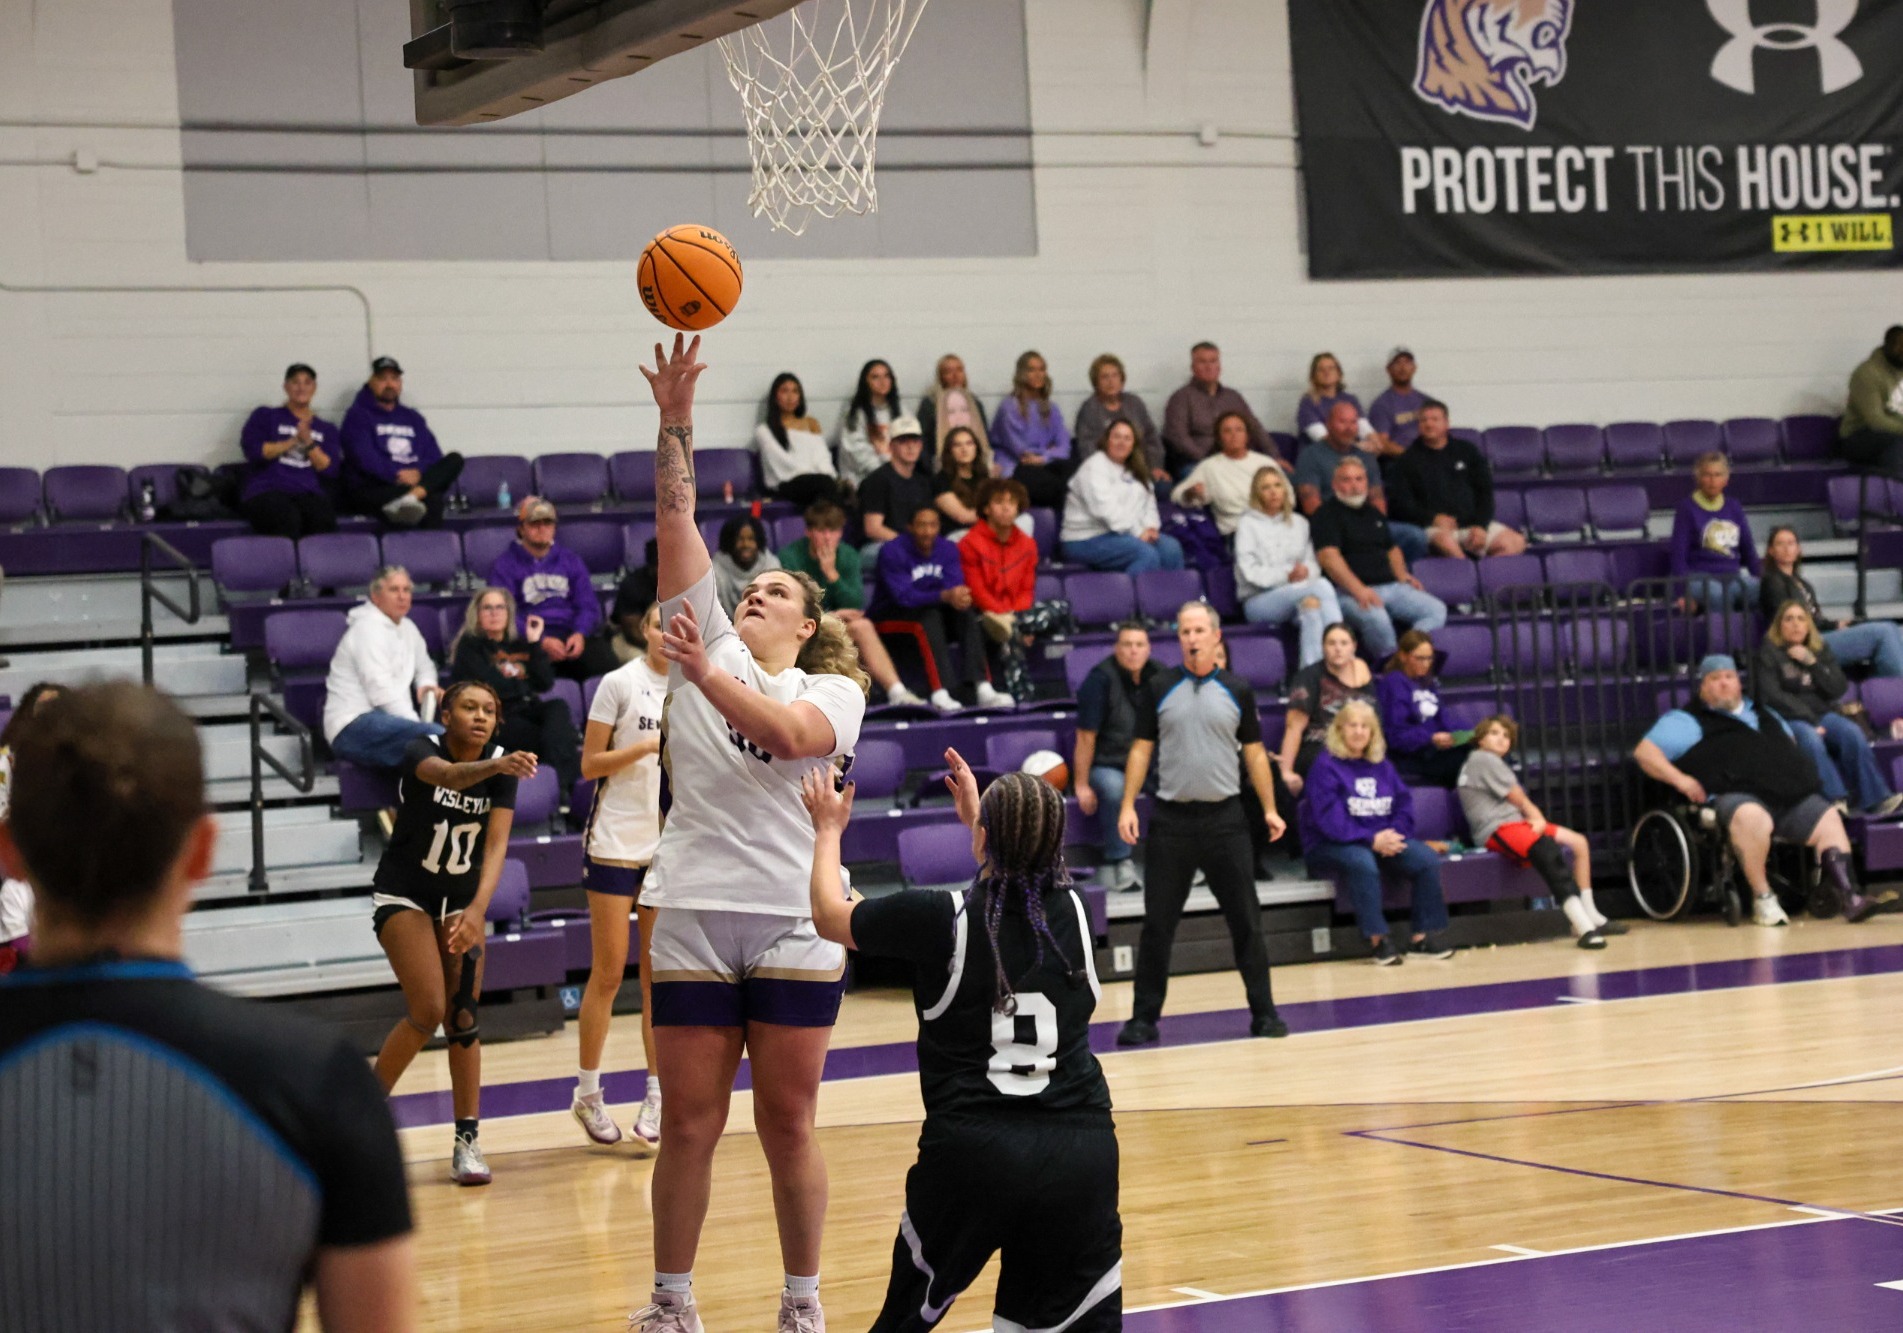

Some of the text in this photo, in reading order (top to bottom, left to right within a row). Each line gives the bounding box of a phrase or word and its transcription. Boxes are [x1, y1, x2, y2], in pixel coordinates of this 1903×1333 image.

[1401, 143, 1900, 214] PROTECT THIS HOUSE.
[1816, 222, 1825, 243] I
[421, 818, 482, 875] 10
[986, 991, 1058, 1096] 8
